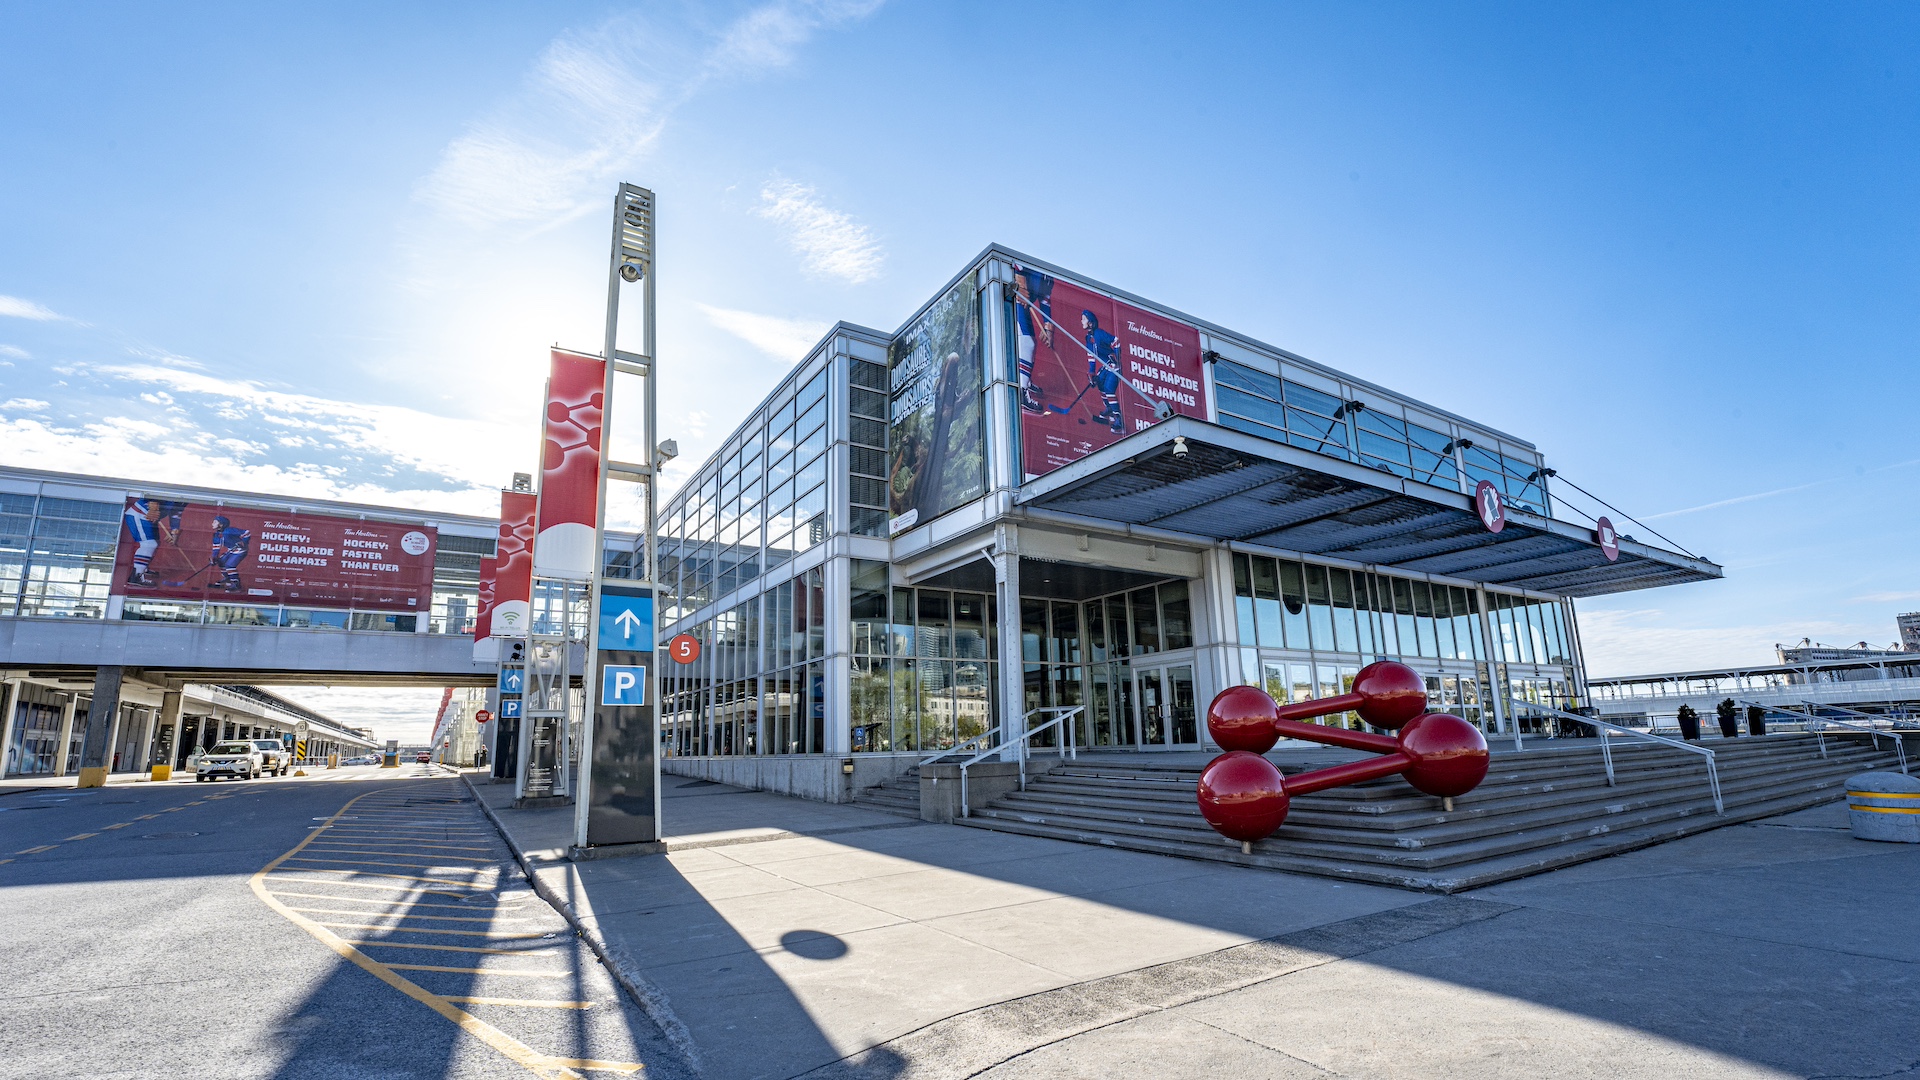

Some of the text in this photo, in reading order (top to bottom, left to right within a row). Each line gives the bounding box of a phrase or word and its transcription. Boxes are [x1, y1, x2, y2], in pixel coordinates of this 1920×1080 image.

[905, 297, 954, 346] IMAX TELUS
[1127, 320, 1163, 341] Tim Hortons
[1129, 343, 1175, 369] HOCKEY:
[1130, 360, 1199, 392] PLUS RAPIDE
[890, 374, 933, 421] DINOSAURS
[1155, 386, 1196, 407] JAMAIS
[966, 485, 980, 495] TELUS
[275, 522, 300, 531] Hortons
[261, 531, 311, 543] HOCKEY:
[355, 530, 378, 538] Hortons
[260, 542, 334, 556] PLUS RAPIDE
[343, 539, 389, 550] HOCKEY:
[258, 554, 328, 567] QUE JAMAIS
[342, 550, 382, 560] FASTER
[341, 561, 399, 572] THAN EVER
[680, 641, 691, 657] 5
[614, 671, 636, 699] P
[507, 702, 518, 716] P
